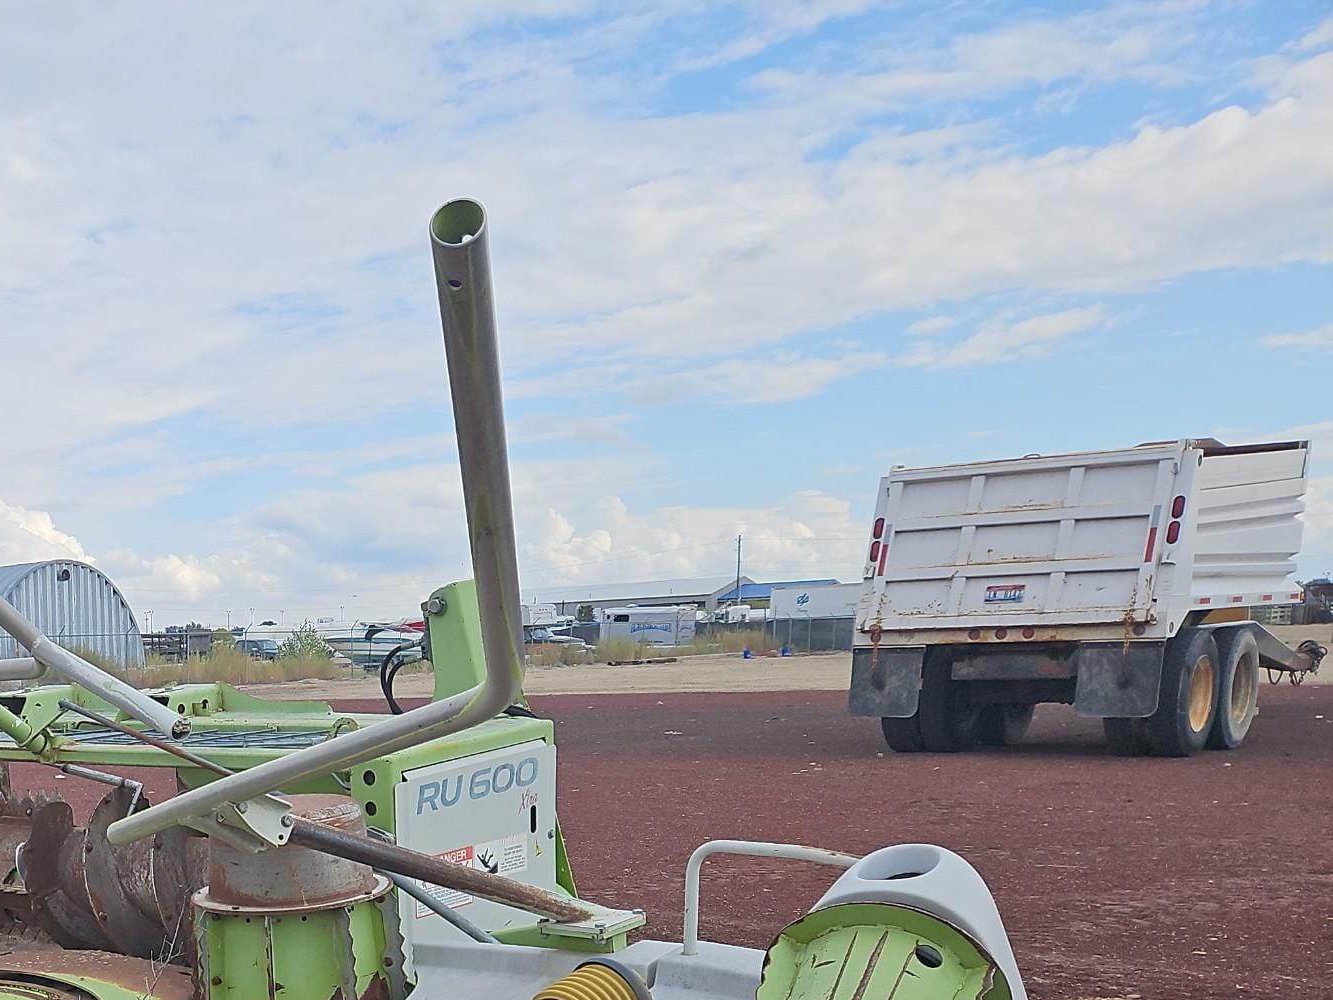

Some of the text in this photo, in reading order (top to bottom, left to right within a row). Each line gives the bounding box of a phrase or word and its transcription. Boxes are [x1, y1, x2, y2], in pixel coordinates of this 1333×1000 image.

[416, 757, 539, 816] RU 600
[439, 849, 467, 862] ANGER
